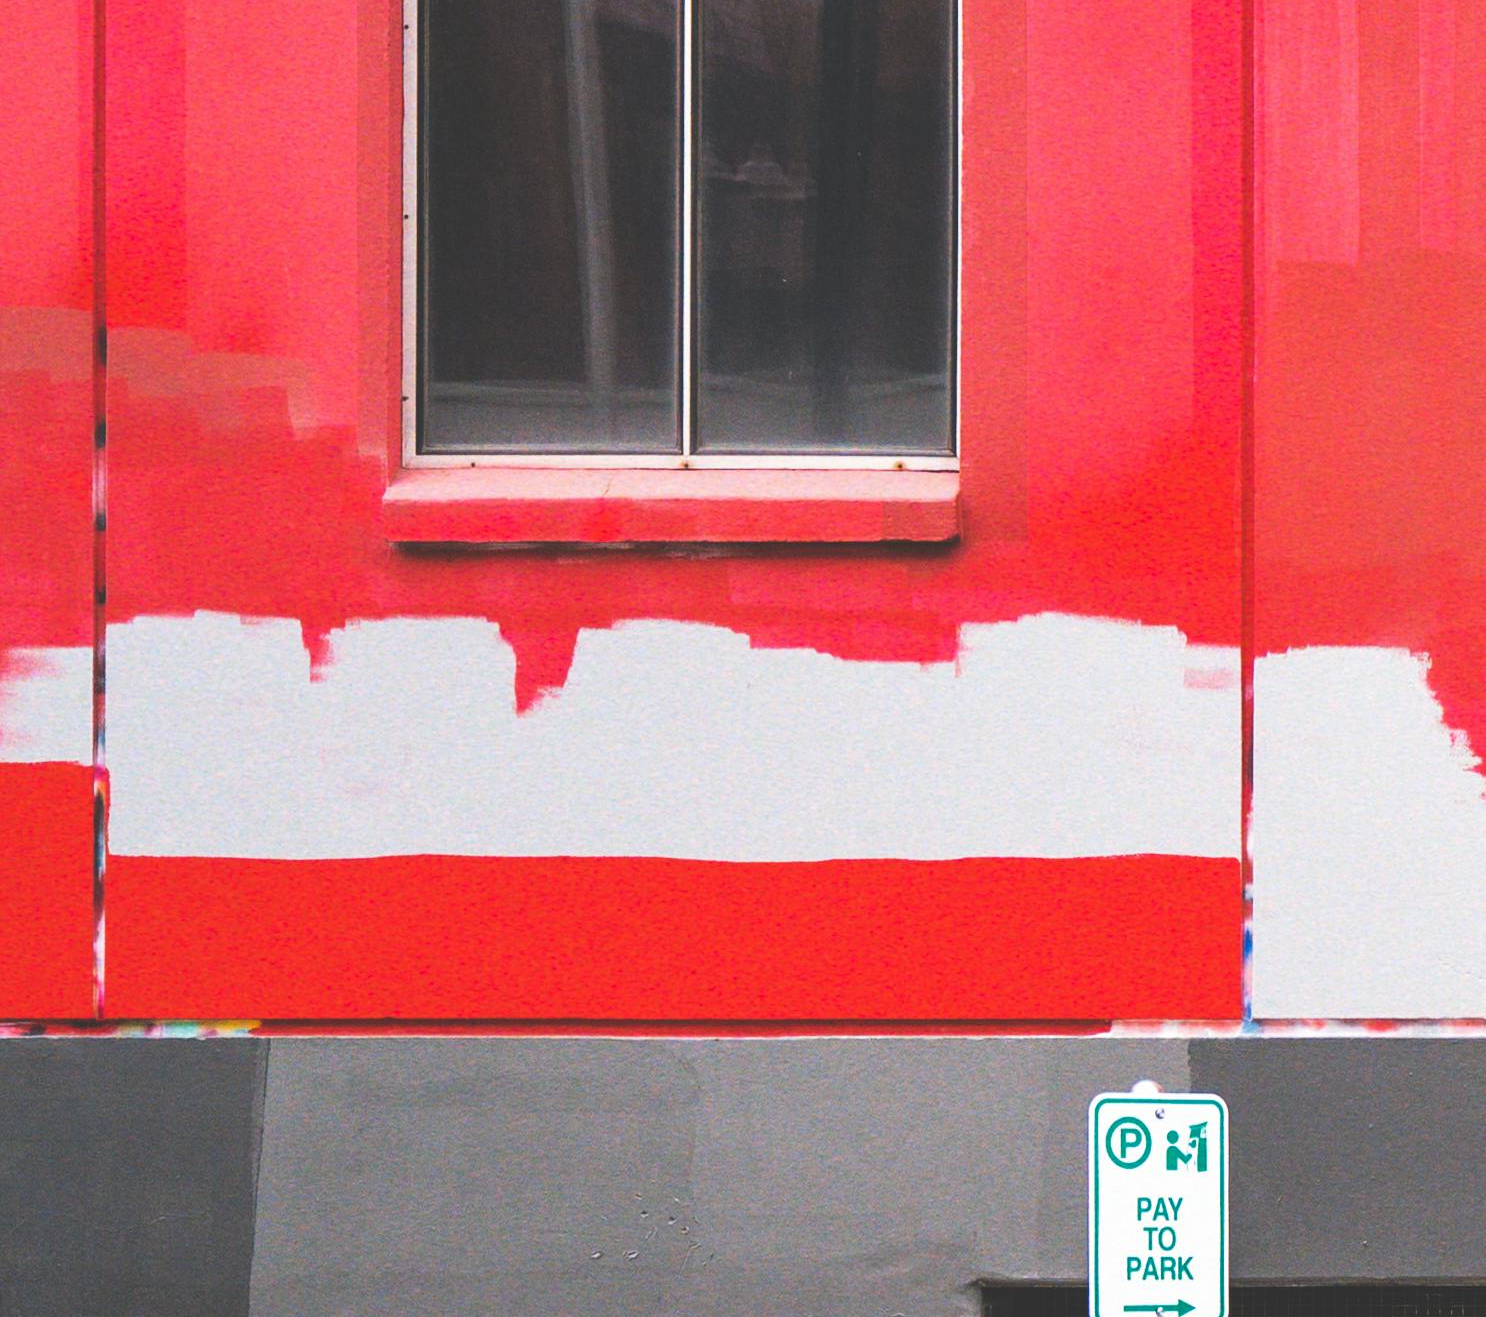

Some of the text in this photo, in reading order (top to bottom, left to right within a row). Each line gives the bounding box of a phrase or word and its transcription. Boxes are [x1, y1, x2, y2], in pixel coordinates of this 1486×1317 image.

[1120, 1128, 1143, 1159] P
[1137, 1197, 1183, 1222] PAY
[1143, 1227, 1177, 1251] TO
[1126, 1256, 1194, 1281] PARK
